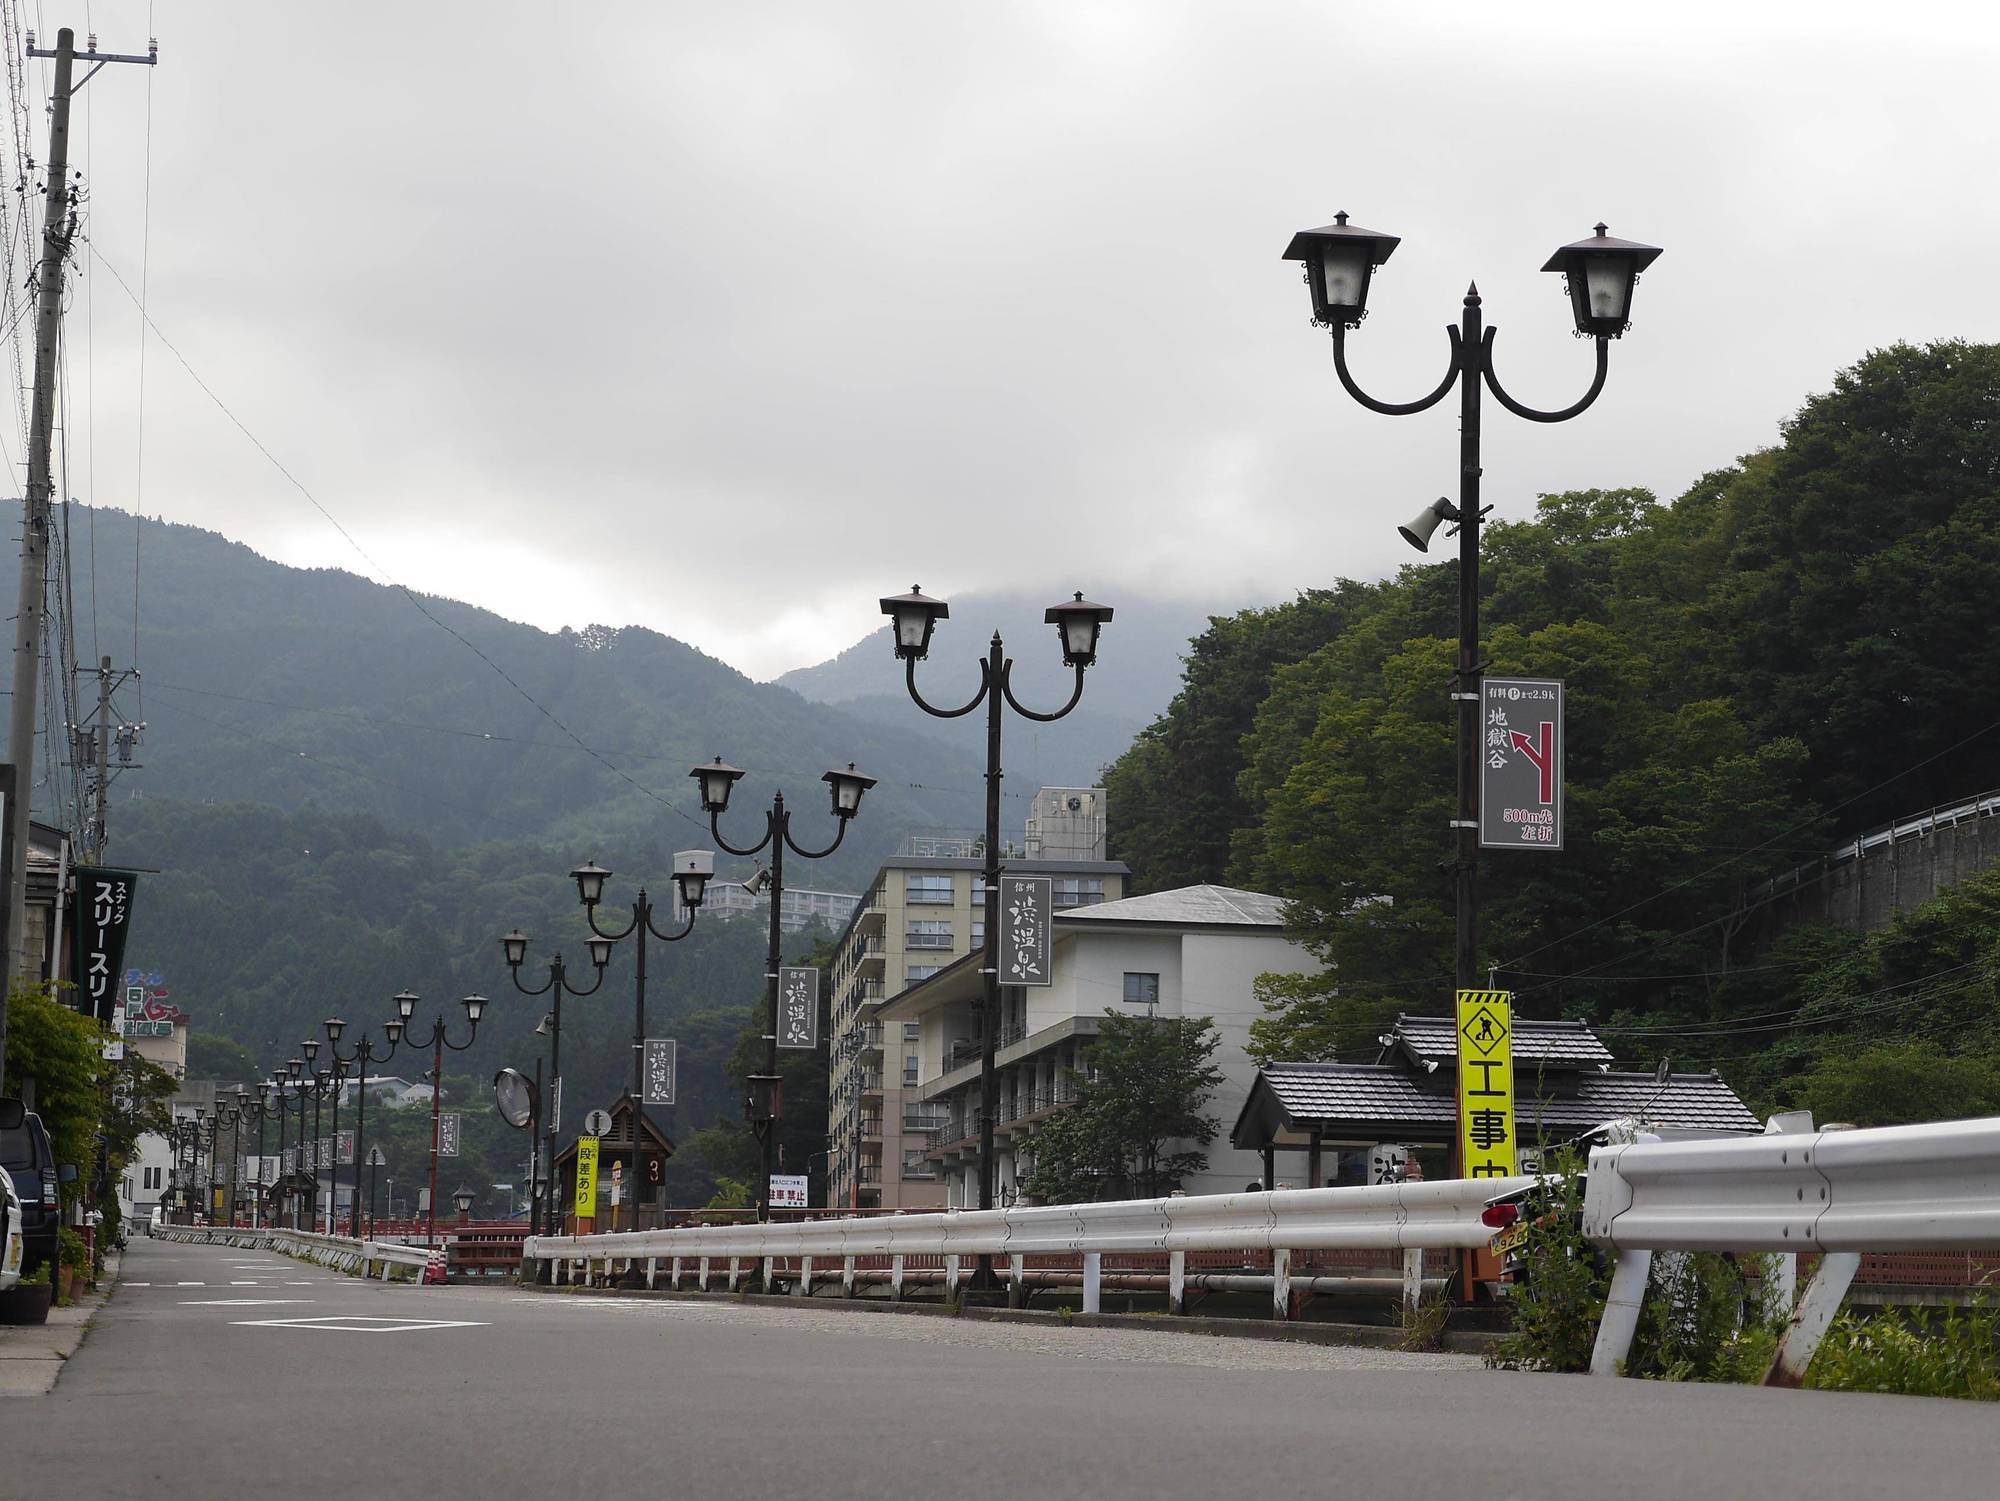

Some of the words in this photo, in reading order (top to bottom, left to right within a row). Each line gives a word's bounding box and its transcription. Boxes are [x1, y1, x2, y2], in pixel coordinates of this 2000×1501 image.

[1486, 706, 1509, 770] 地獄谷
[1503, 808, 1554, 825] 500m先
[1521, 825, 1553, 842] 左折
[113, 881, 127, 925] スナック
[1014, 882, 1035, 893] 信州
[89, 881, 114, 1019] スリースリー
[1008, 895, 1041, 979] 渋温泉
[785, 981, 809, 1044] 渋温泉
[578, 1147, 592, 1204] 段差あり
[649, 1160, 659, 1181] 3
